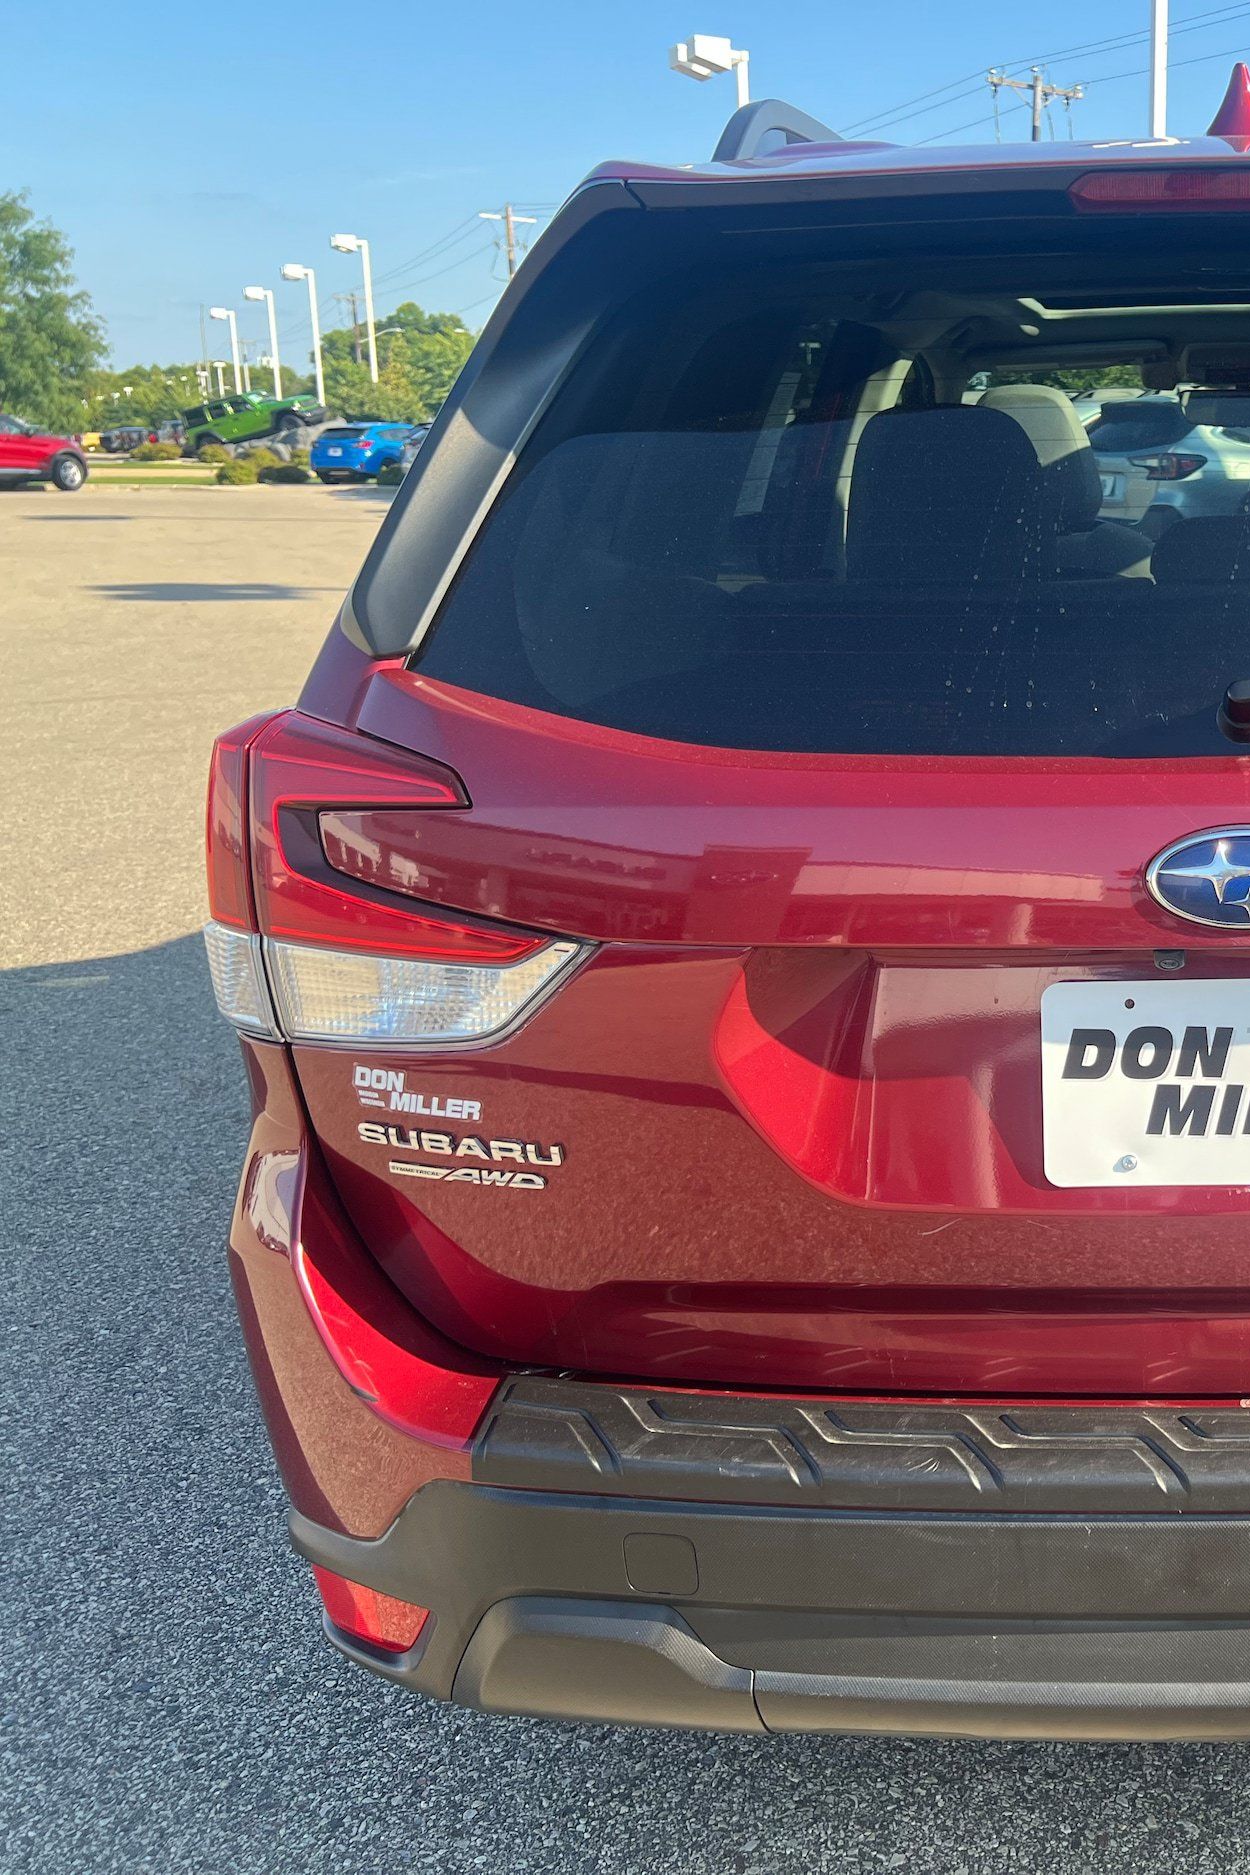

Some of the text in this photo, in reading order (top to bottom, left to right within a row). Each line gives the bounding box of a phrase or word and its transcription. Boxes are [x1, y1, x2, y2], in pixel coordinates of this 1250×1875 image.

[1061, 1025, 1235, 1080] DON
[354, 1065, 405, 1093] DON
[389, 1090, 482, 1121] MILLER
[356, 1121, 565, 1167] SUBARU
[444, 1166, 548, 1190] AWD
